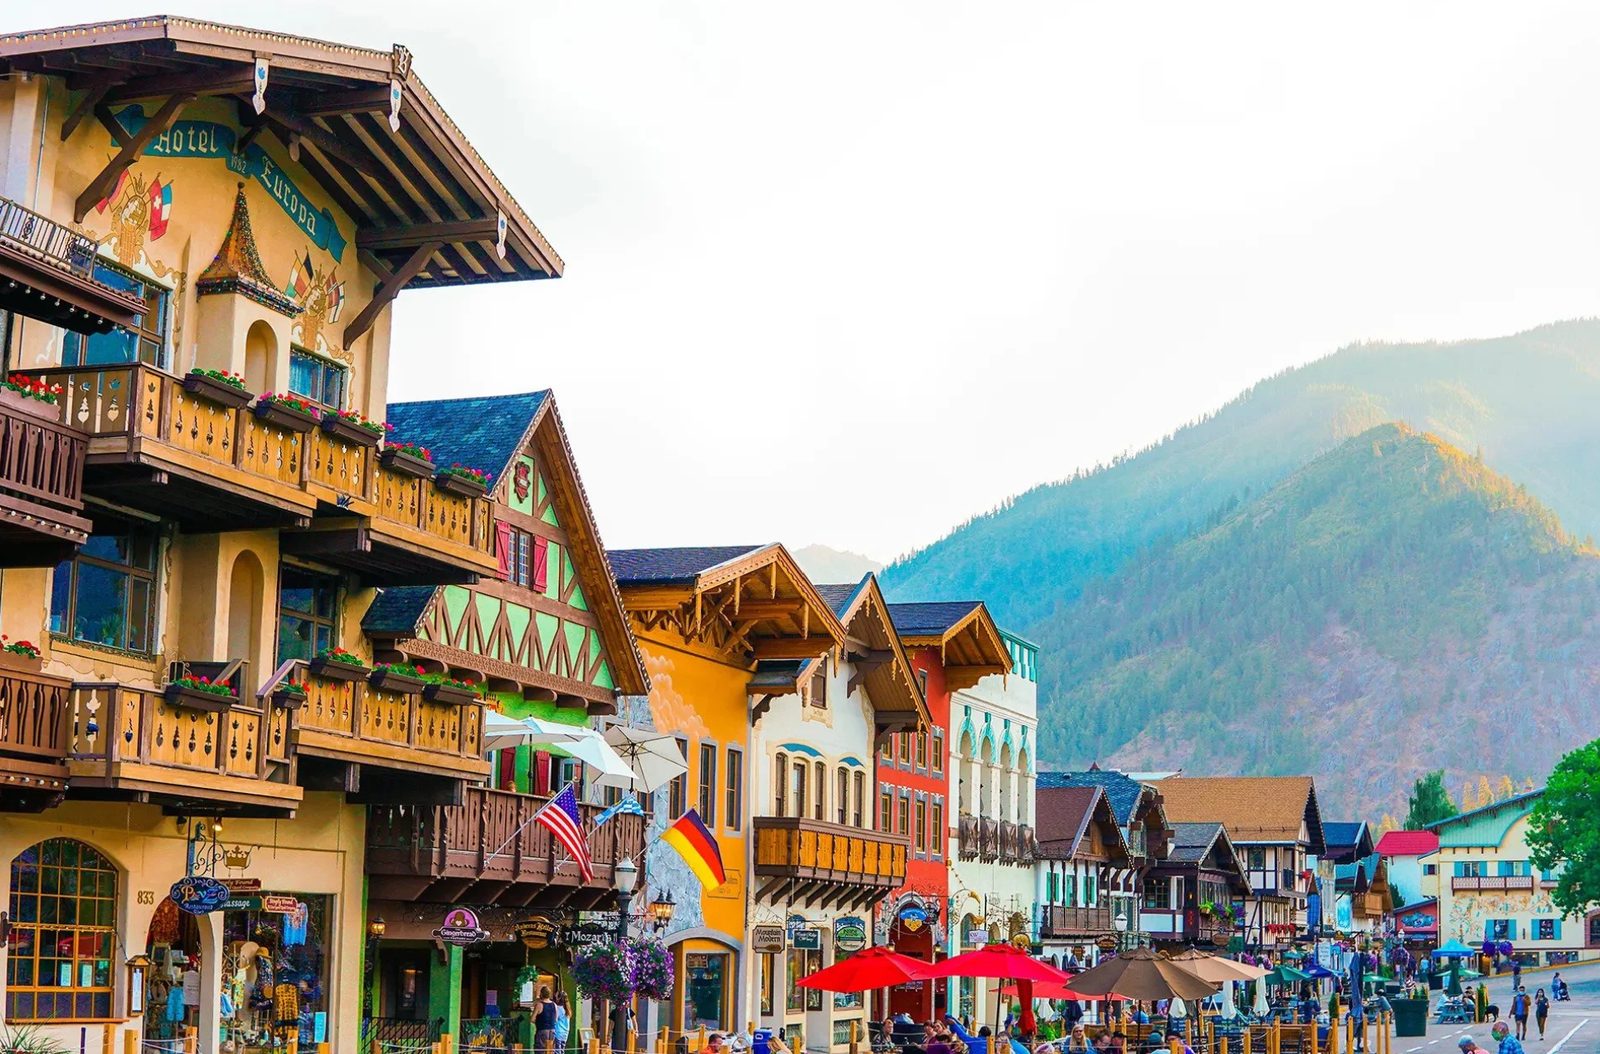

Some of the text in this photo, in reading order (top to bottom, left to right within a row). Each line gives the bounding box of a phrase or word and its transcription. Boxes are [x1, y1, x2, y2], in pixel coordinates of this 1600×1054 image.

[153, 125, 219, 154] Hotel
[231, 154, 248, 174] 1982
[261, 155, 316, 236] Europa
[137, 890, 155, 905] 833
[440, 929, 477, 938] Gingerbread
[758, 935, 781, 943] Modern
